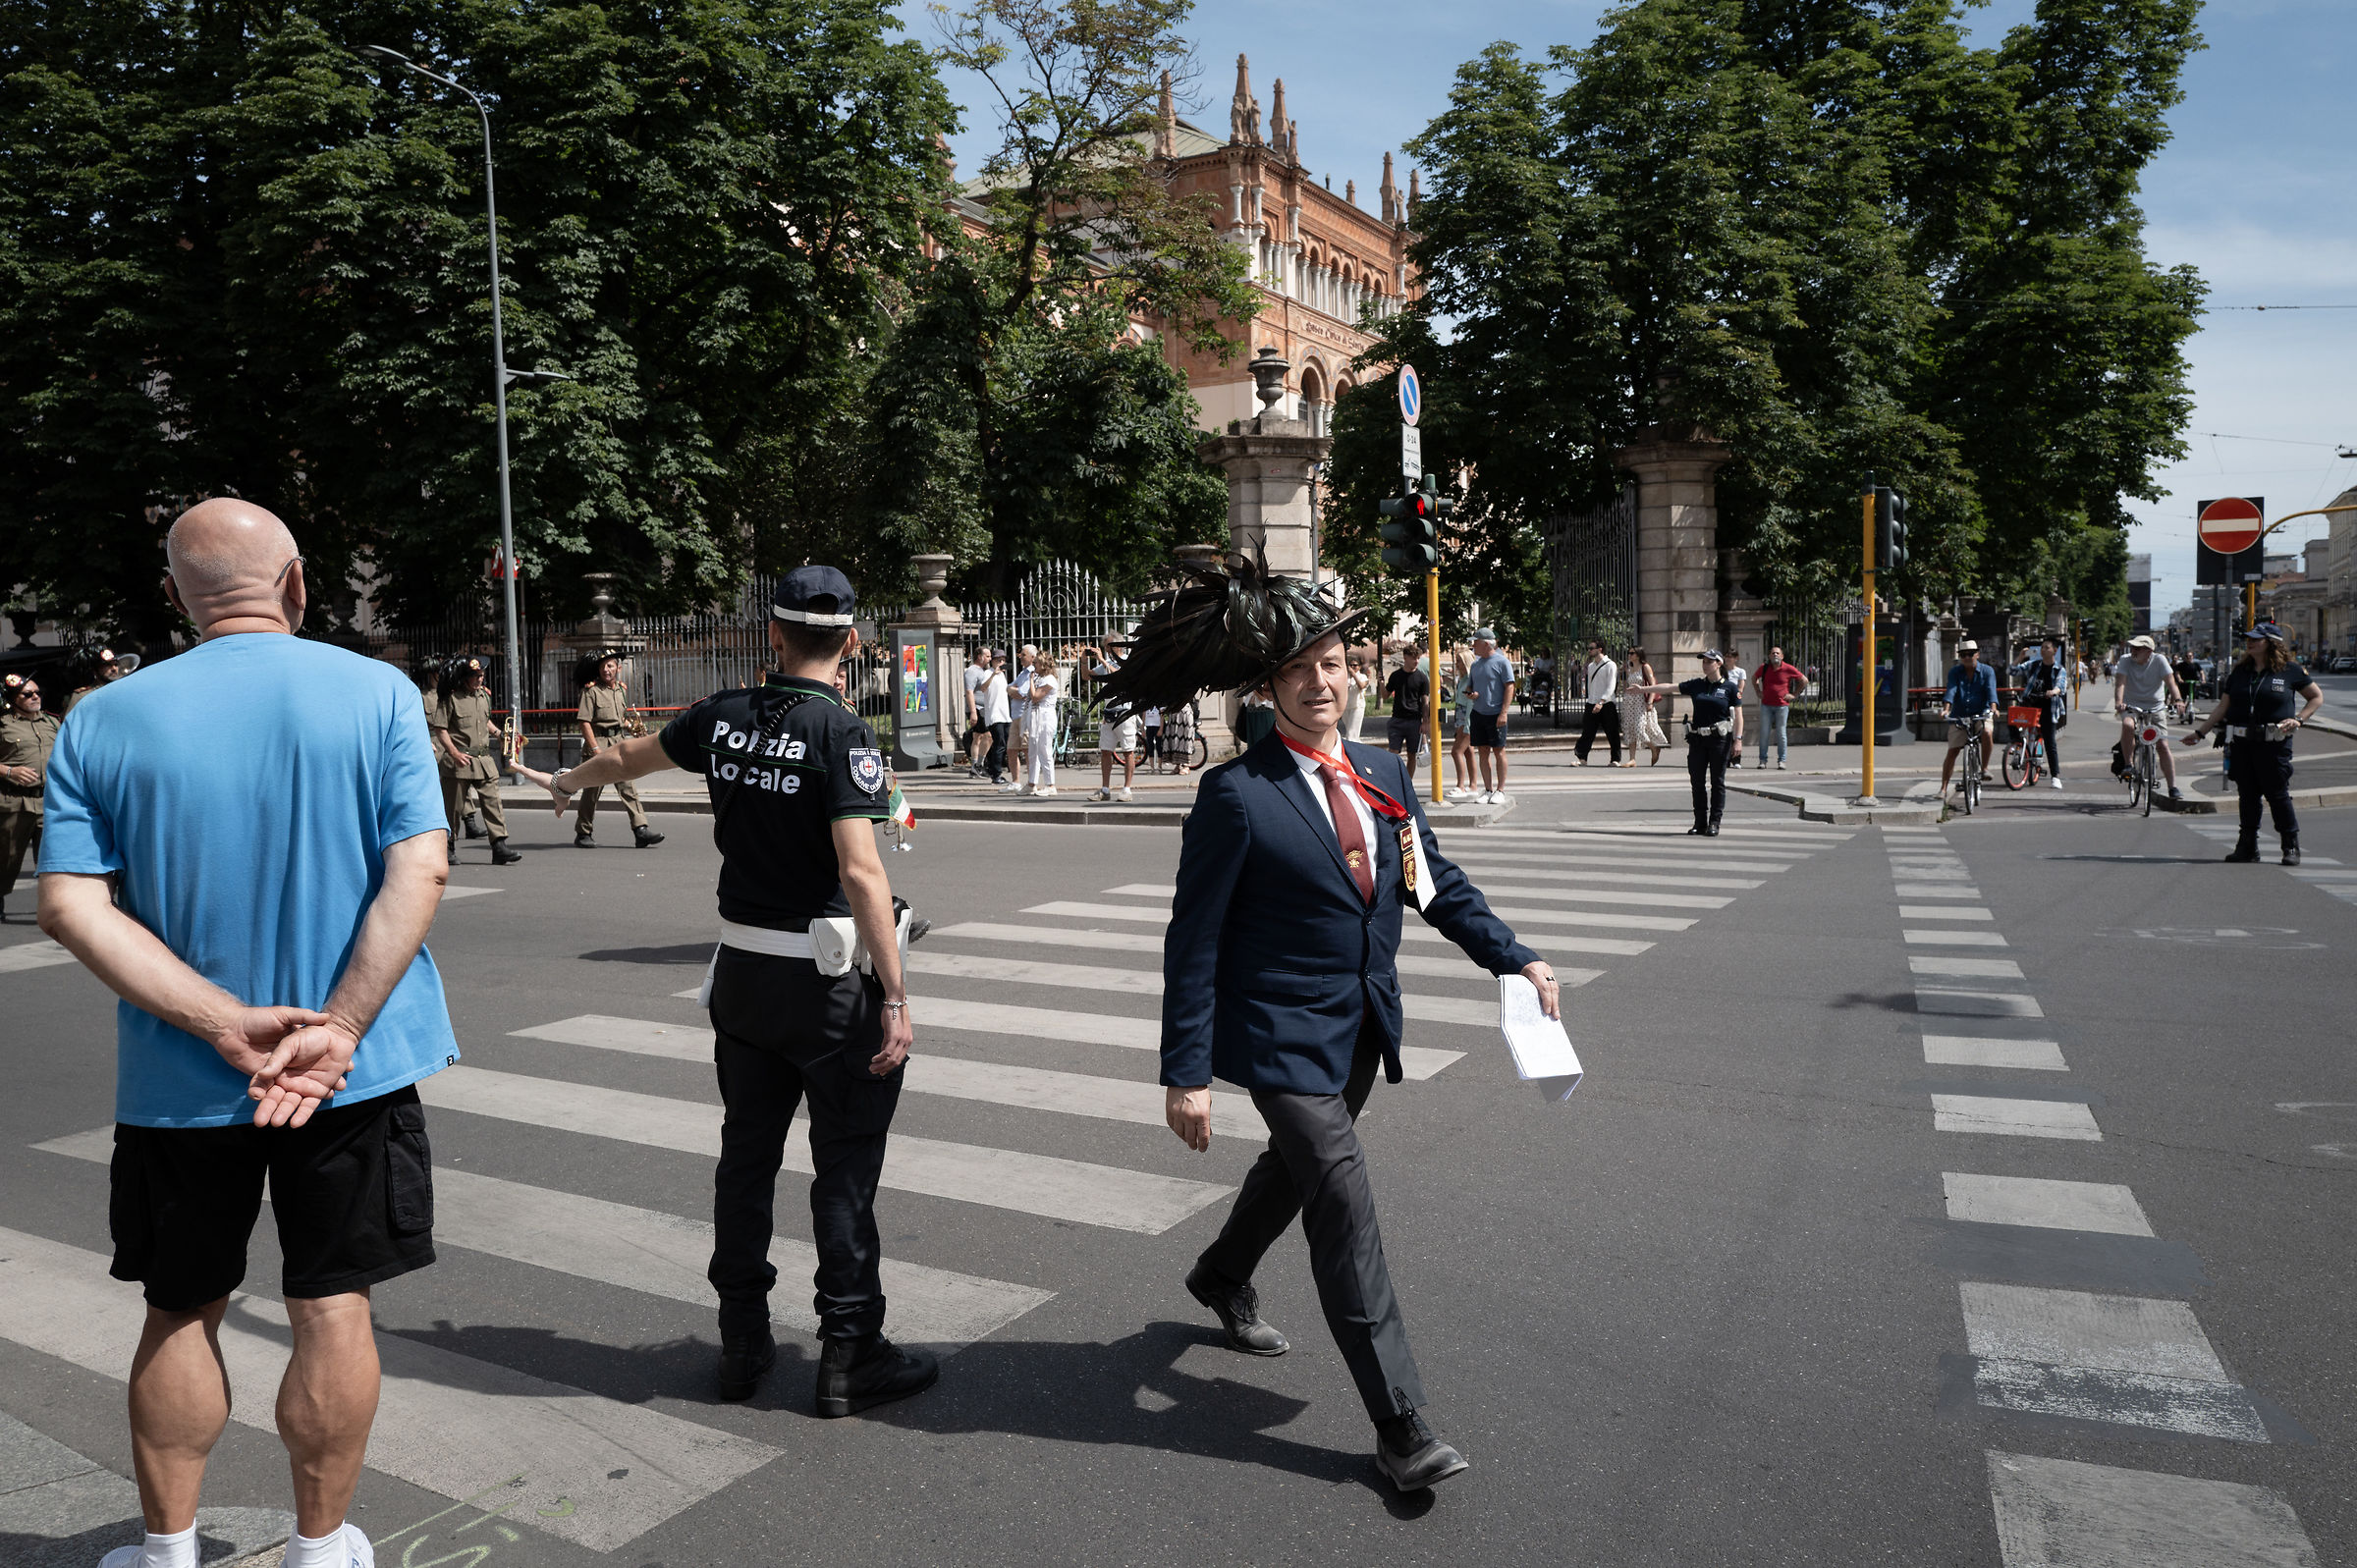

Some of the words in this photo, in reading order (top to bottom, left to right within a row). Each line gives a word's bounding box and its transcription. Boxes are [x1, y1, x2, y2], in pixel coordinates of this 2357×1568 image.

[712, 720, 806, 760] Polzia
[711, 753, 800, 794] Locale
[852, 766, 869, 790] COMUNE
